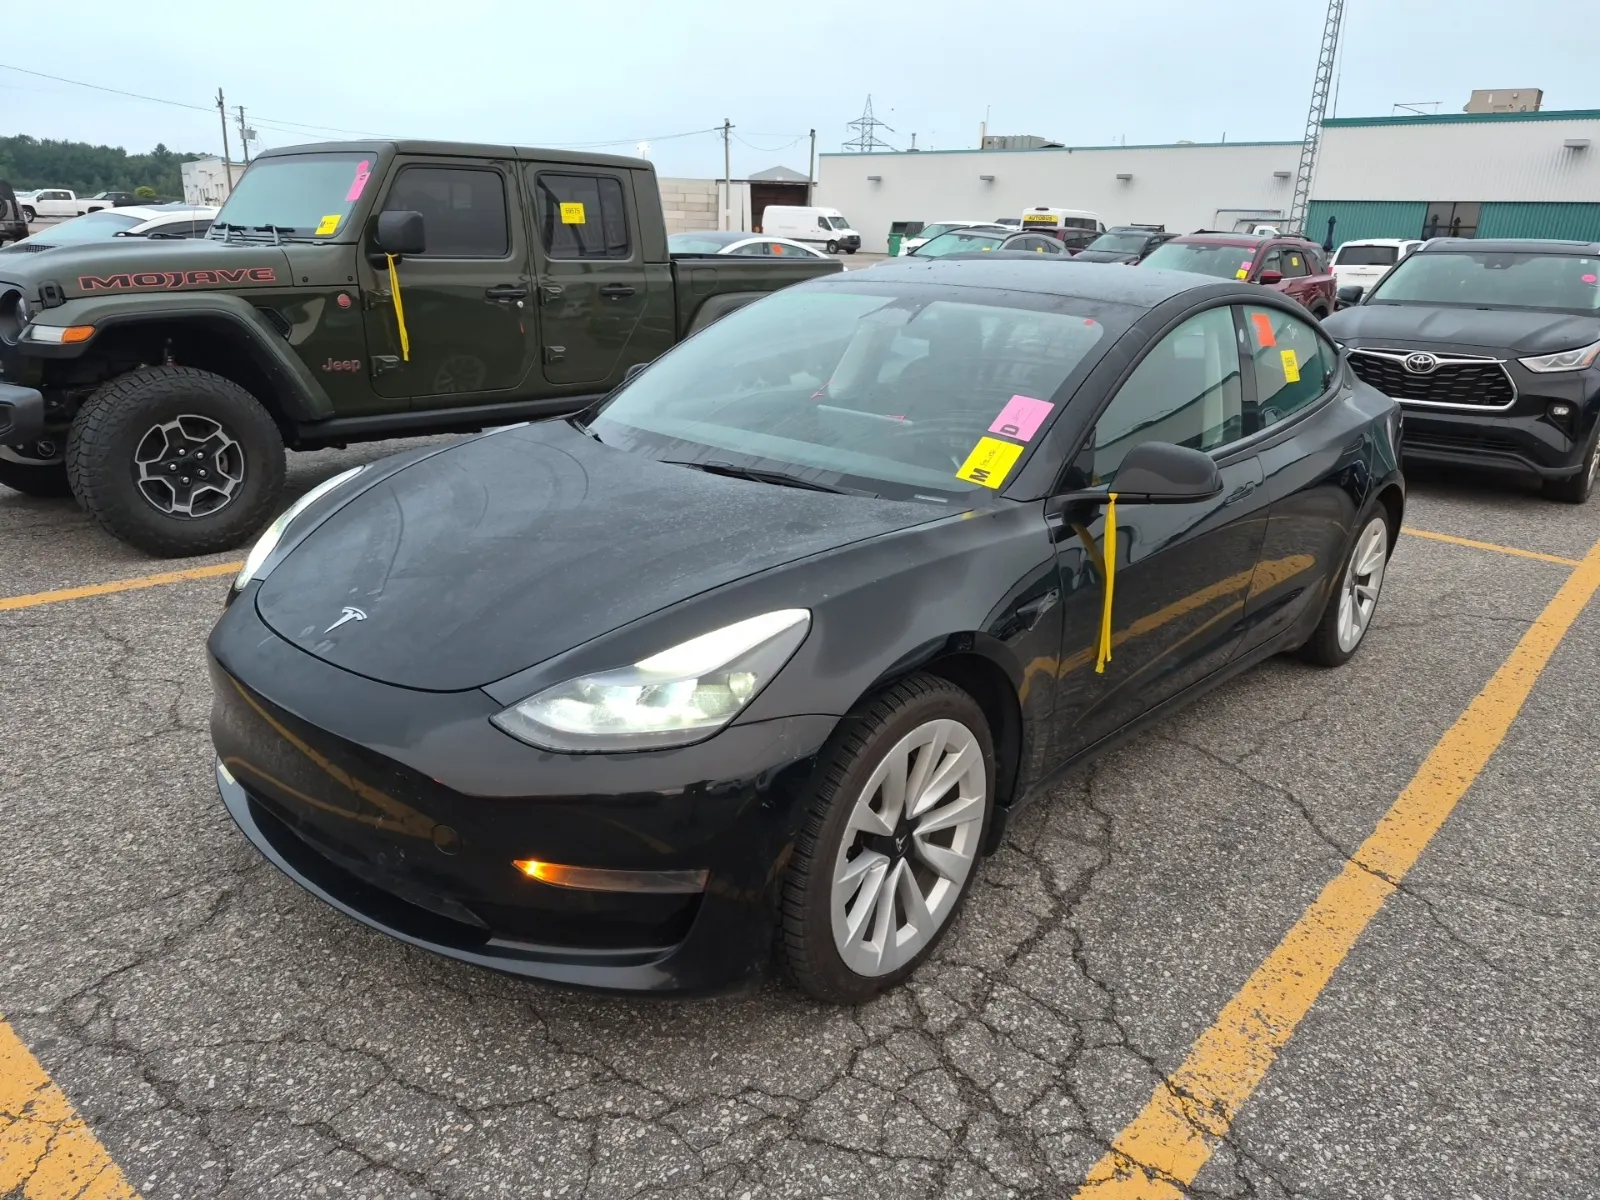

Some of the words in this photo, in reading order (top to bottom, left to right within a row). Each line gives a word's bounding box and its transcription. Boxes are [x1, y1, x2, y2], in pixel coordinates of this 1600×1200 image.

[78, 267, 276, 291] MOJAVE
[322, 357, 362, 373] Jeep
[1000, 423, 1020, 436] D
[969, 467, 991, 482] M
